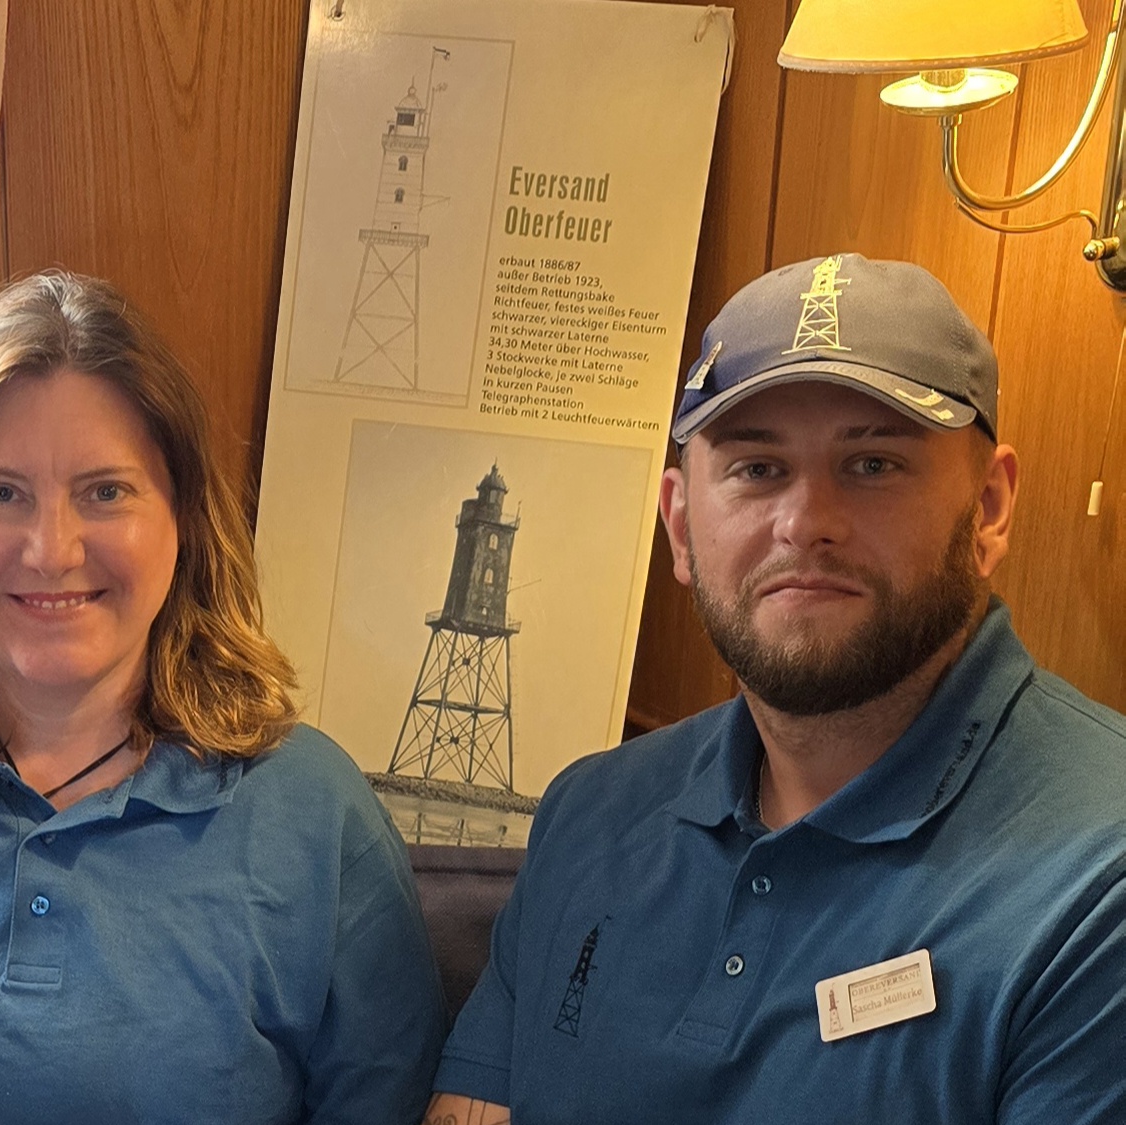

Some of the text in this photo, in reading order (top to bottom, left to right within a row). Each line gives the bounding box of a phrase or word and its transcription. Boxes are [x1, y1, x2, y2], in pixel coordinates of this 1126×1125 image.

[509, 166, 610, 203] Eversand
[504, 205, 613, 243] Oberfeuer
[499, 256, 581, 272] erbaut 1886/87
[497, 270, 603, 289] außer Betrieb 1923,
[495, 283, 615, 303] seitdem Rettungsbake
[494, 296, 660, 321] Richtfeuer, festes weißes Feuer
[490, 324, 609, 344] mit schwarzer Laterne
[492, 310, 667, 335] schwarzer, viereckiger Eisenturm
[488, 337, 650, 362] 34,30 Meter über Hochwasser,
[486, 350, 623, 373] 3 Stockwerke mit Laterne
[483, 377, 573, 395] in kurzen Pausen
[484, 364, 639, 390] Nebelglocke, je zwei Schläge
[481, 390, 584, 410] Telegraphenstation
[480, 403, 660, 431] Betrieb mit 2 Leuchtfeuerwärtern
[853, 1000, 882, 1014] Sascha
